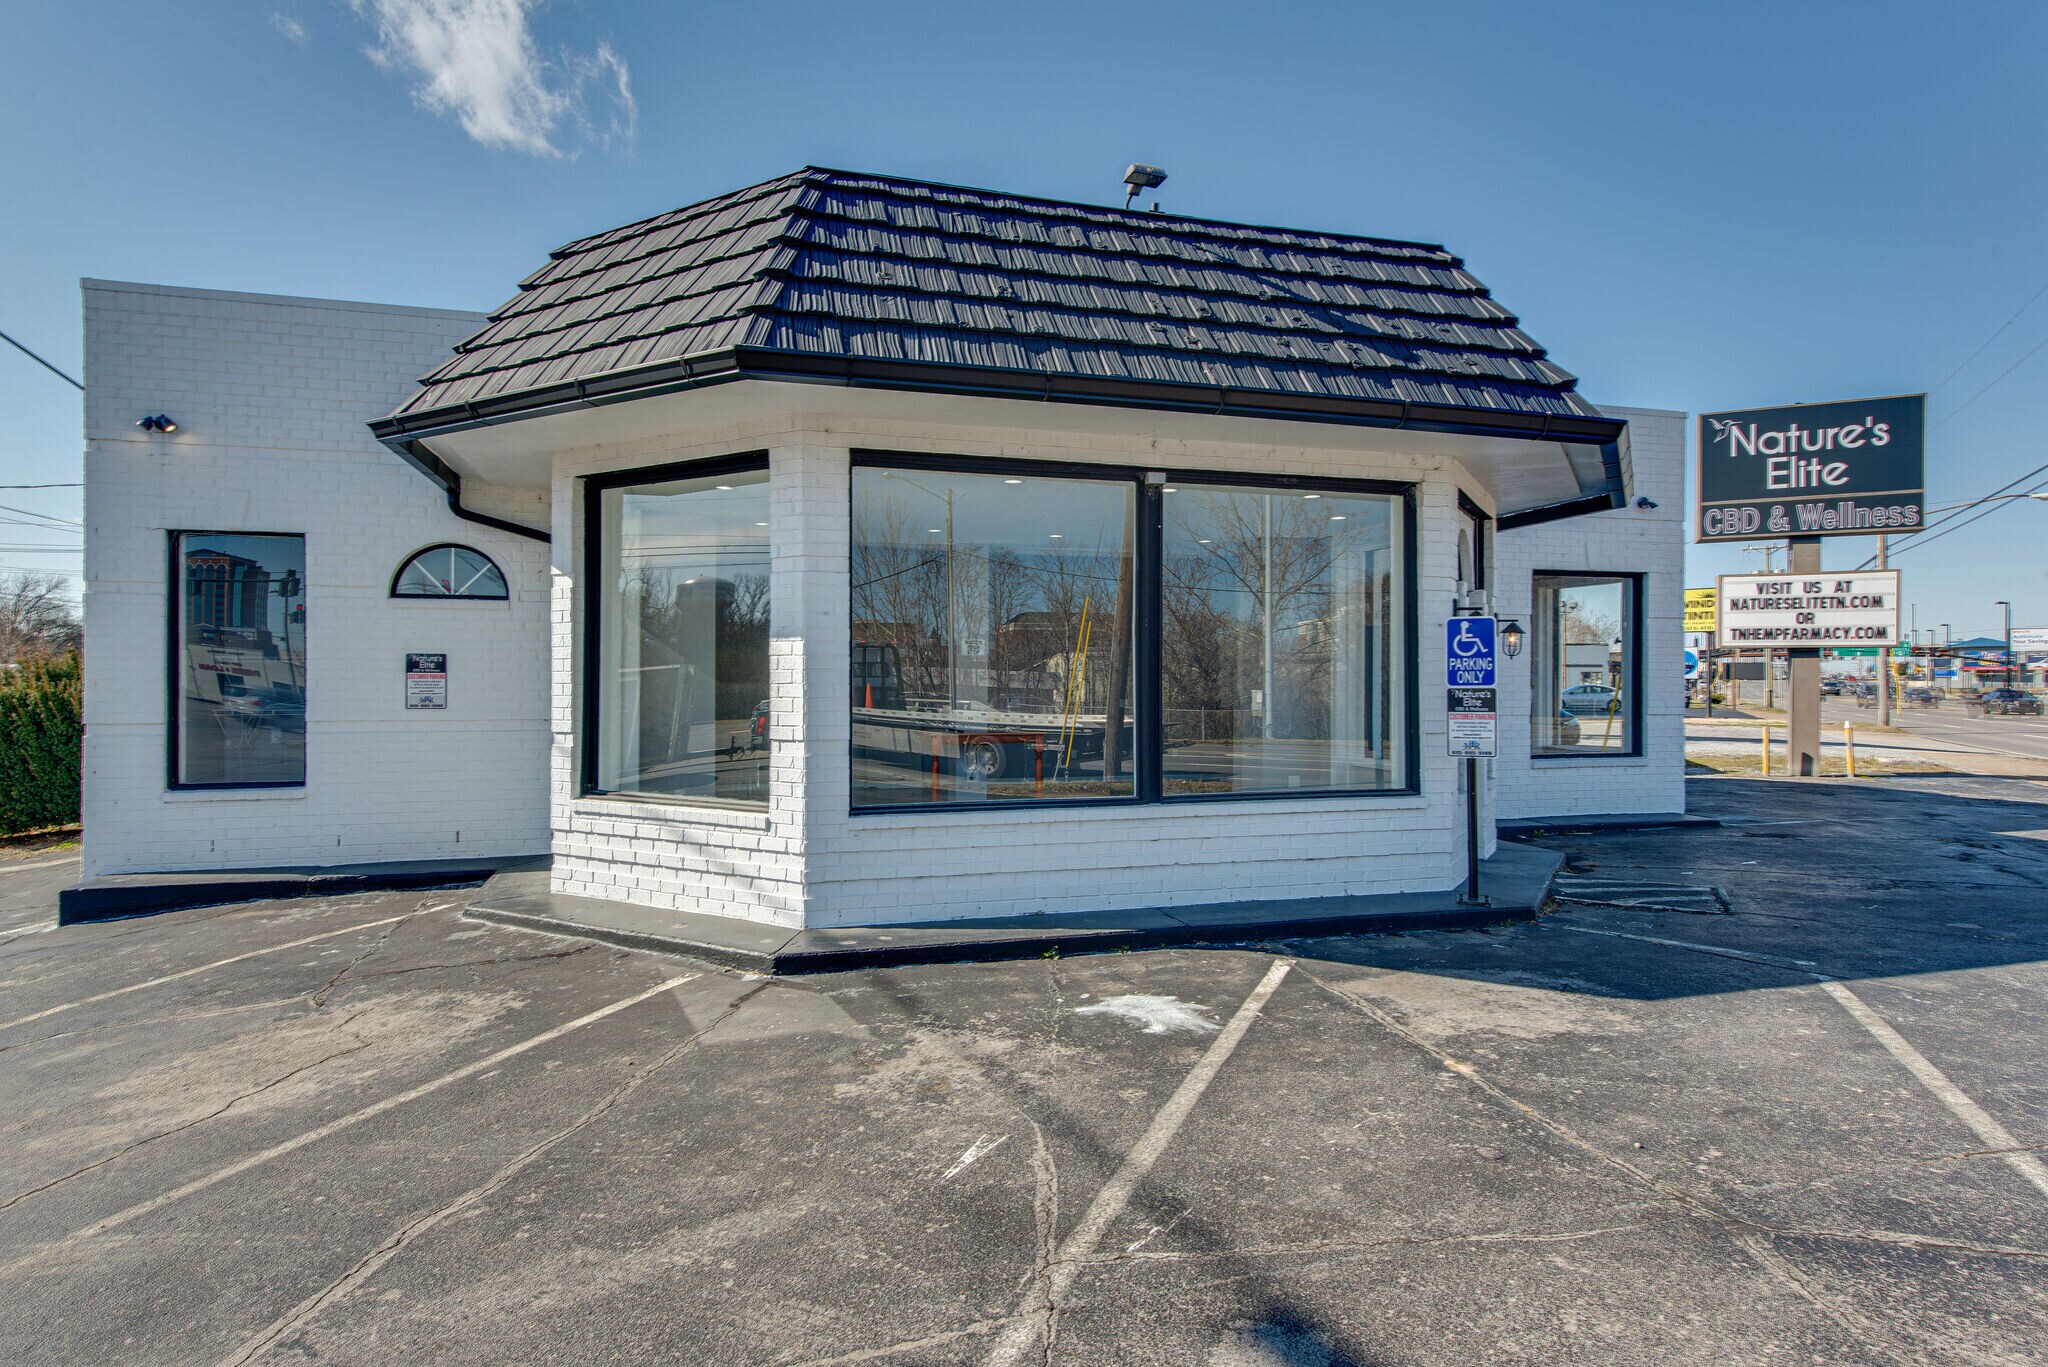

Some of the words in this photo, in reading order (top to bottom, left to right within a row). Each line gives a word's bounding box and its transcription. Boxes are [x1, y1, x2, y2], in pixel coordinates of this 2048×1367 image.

[1729, 415, 1892, 457] Nature's
[1766, 455, 1851, 490] Elite
[1703, 506, 1761, 535] CBD
[1767, 505, 1791, 532] &
[1796, 501, 1921, 530] Wellness
[1755, 581, 1793, 595] VISIT
[1803, 580, 1821, 594] US
[1833, 580, 1853, 593] AT
[1730, 595, 1885, 611] NATURESELITETN.COM
[1795, 612, 1816, 625] OR
[1730, 626, 1888, 641] TNHEMPFARMACY.COM
[1449, 657, 1493, 671] PARKING
[1456, 671, 1485, 684] ONLY
[1454, 689, 1491, 698] Nature's
[1463, 698, 1482, 707] Elite
